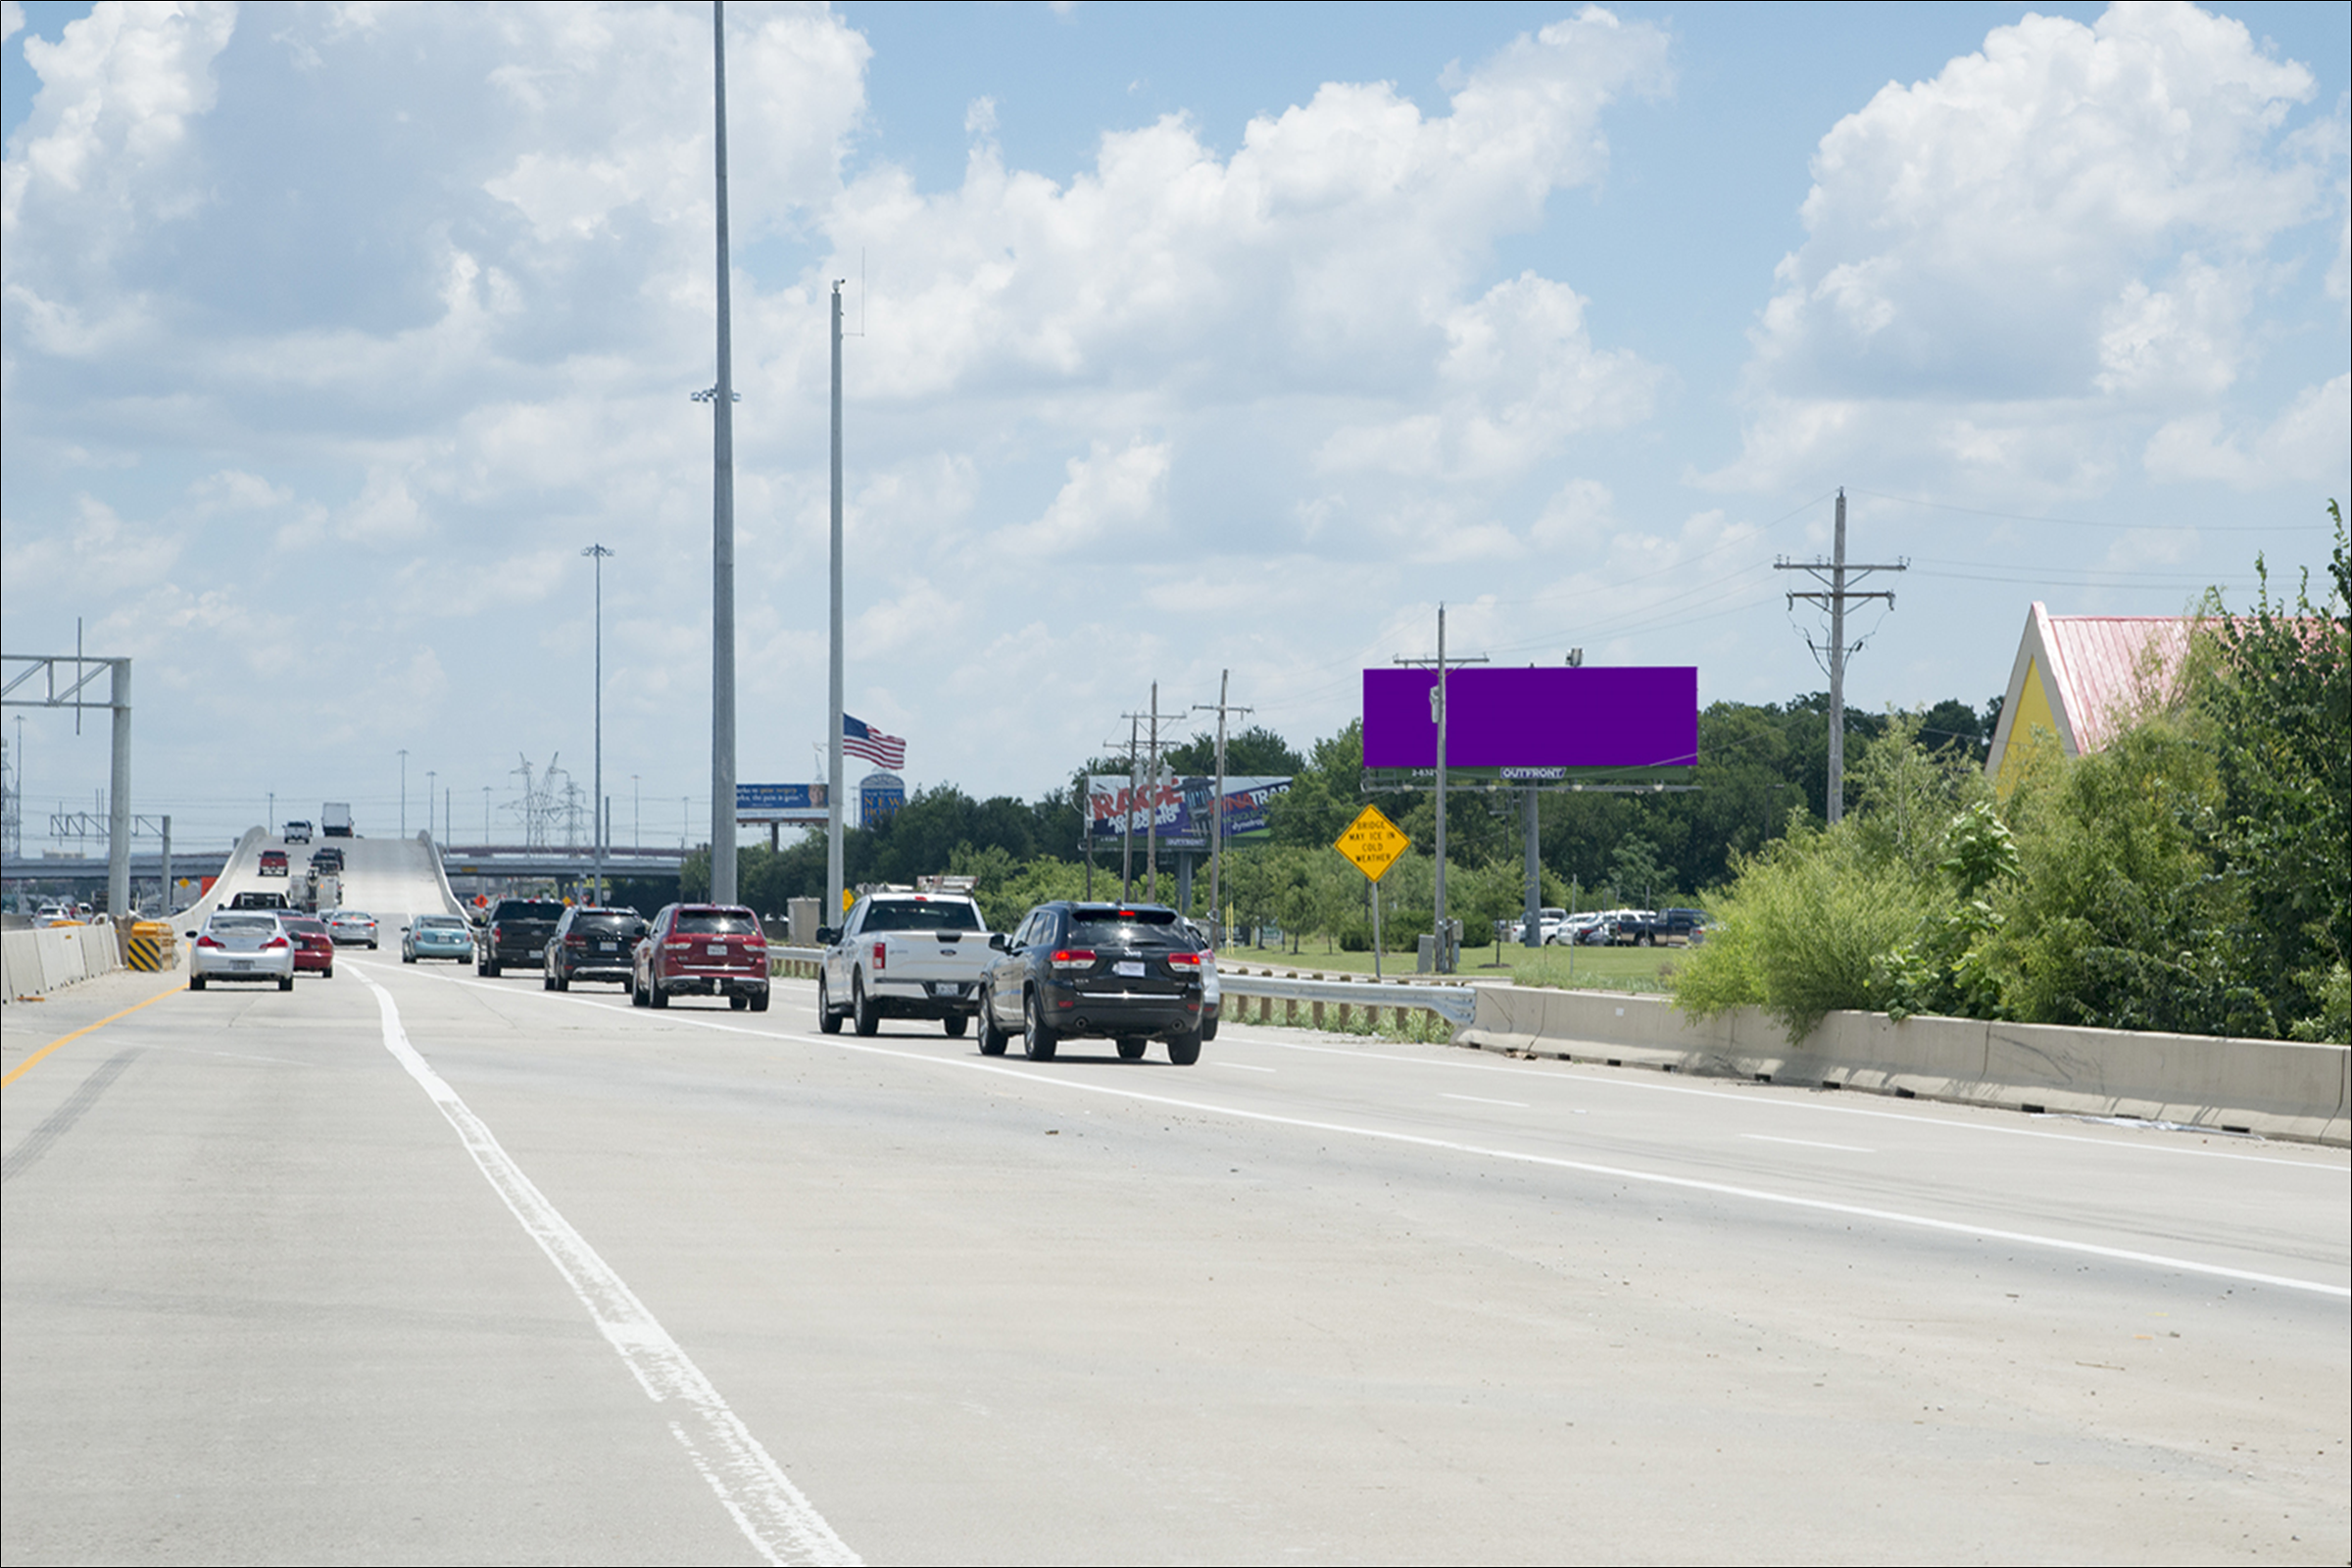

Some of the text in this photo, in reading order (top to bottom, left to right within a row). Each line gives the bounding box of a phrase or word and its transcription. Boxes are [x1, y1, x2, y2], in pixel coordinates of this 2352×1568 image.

[1502, 767, 1563, 778] OUTFRONT
[1356, 820, 1386, 830] BRIDGE
[1348, 831, 1396, 841] MAY ICE IN
[1361, 843, 1384, 853] COLD
[1355, 854, 1392, 863] WEATHER
